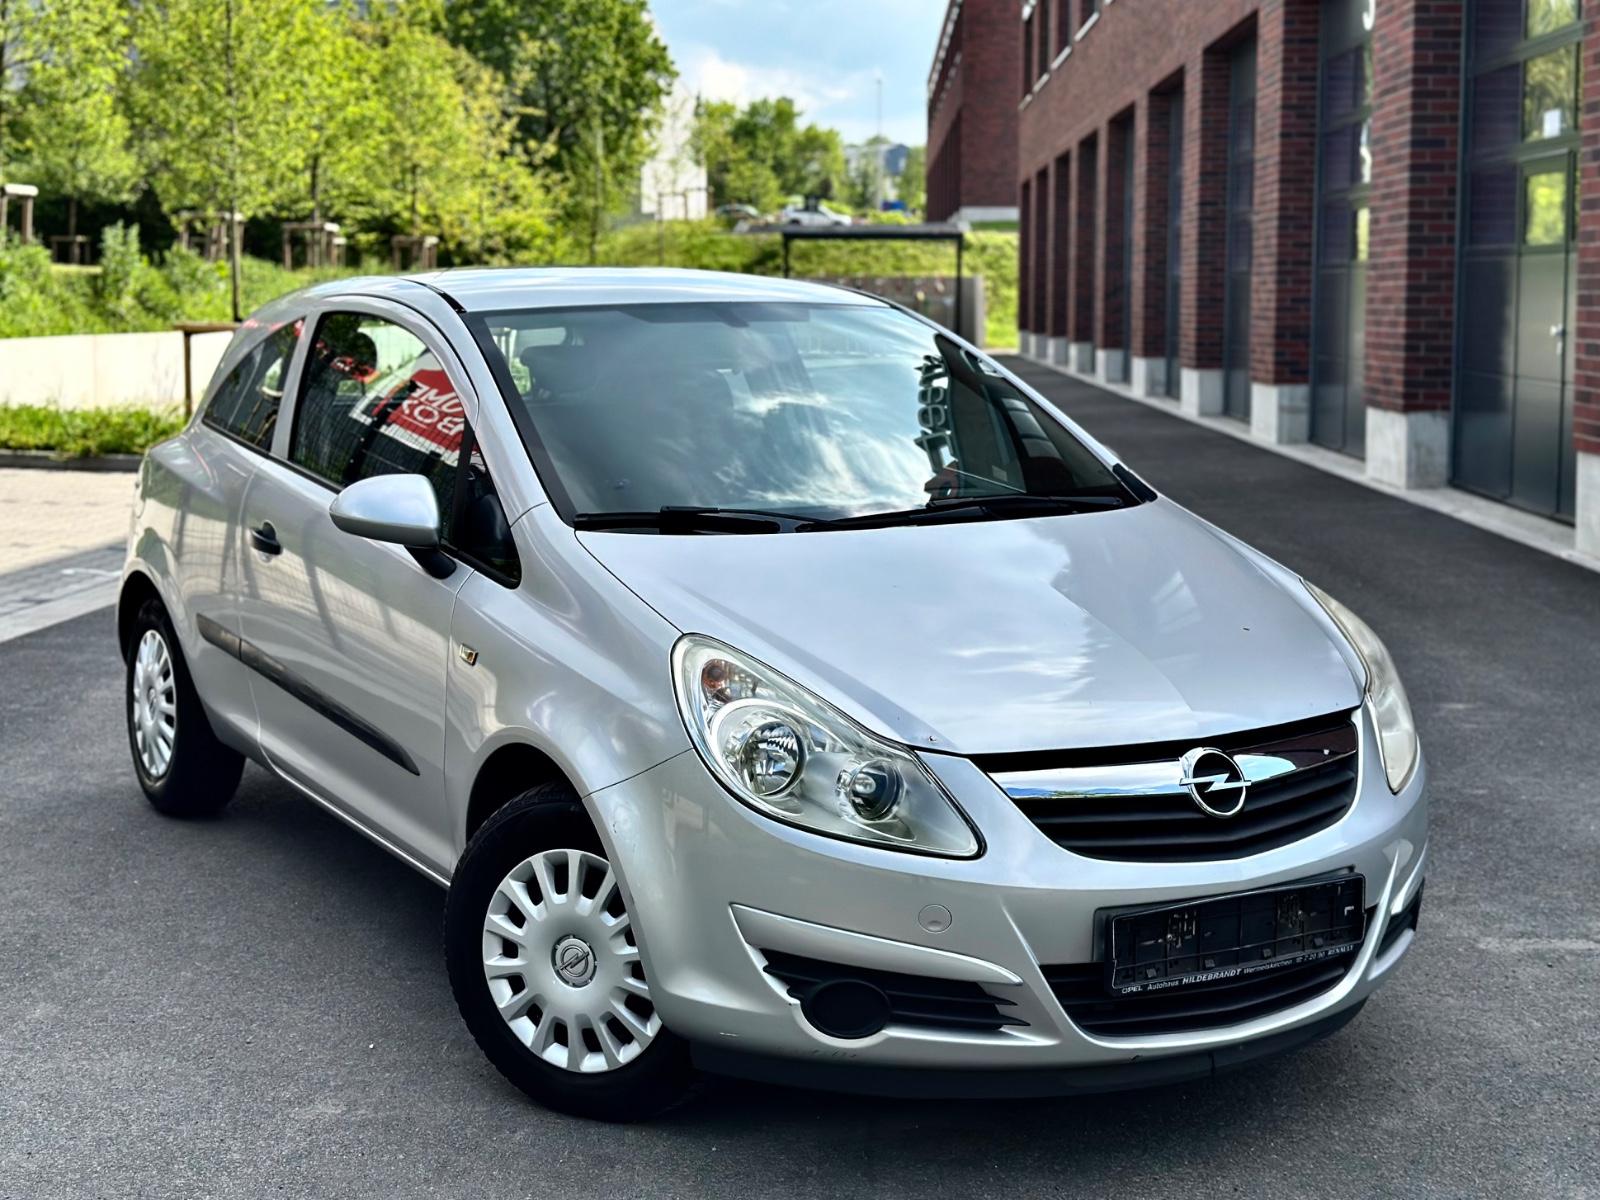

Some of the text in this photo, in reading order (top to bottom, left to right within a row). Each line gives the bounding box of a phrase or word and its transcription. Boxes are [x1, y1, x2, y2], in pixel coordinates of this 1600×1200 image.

[1121, 985, 1143, 994] OPEL
[1147, 980, 1179, 991] Autohaus
[1182, 968, 1243, 985] HILDEBRANDT
[1325, 944, 1354, 955] RENAULT
